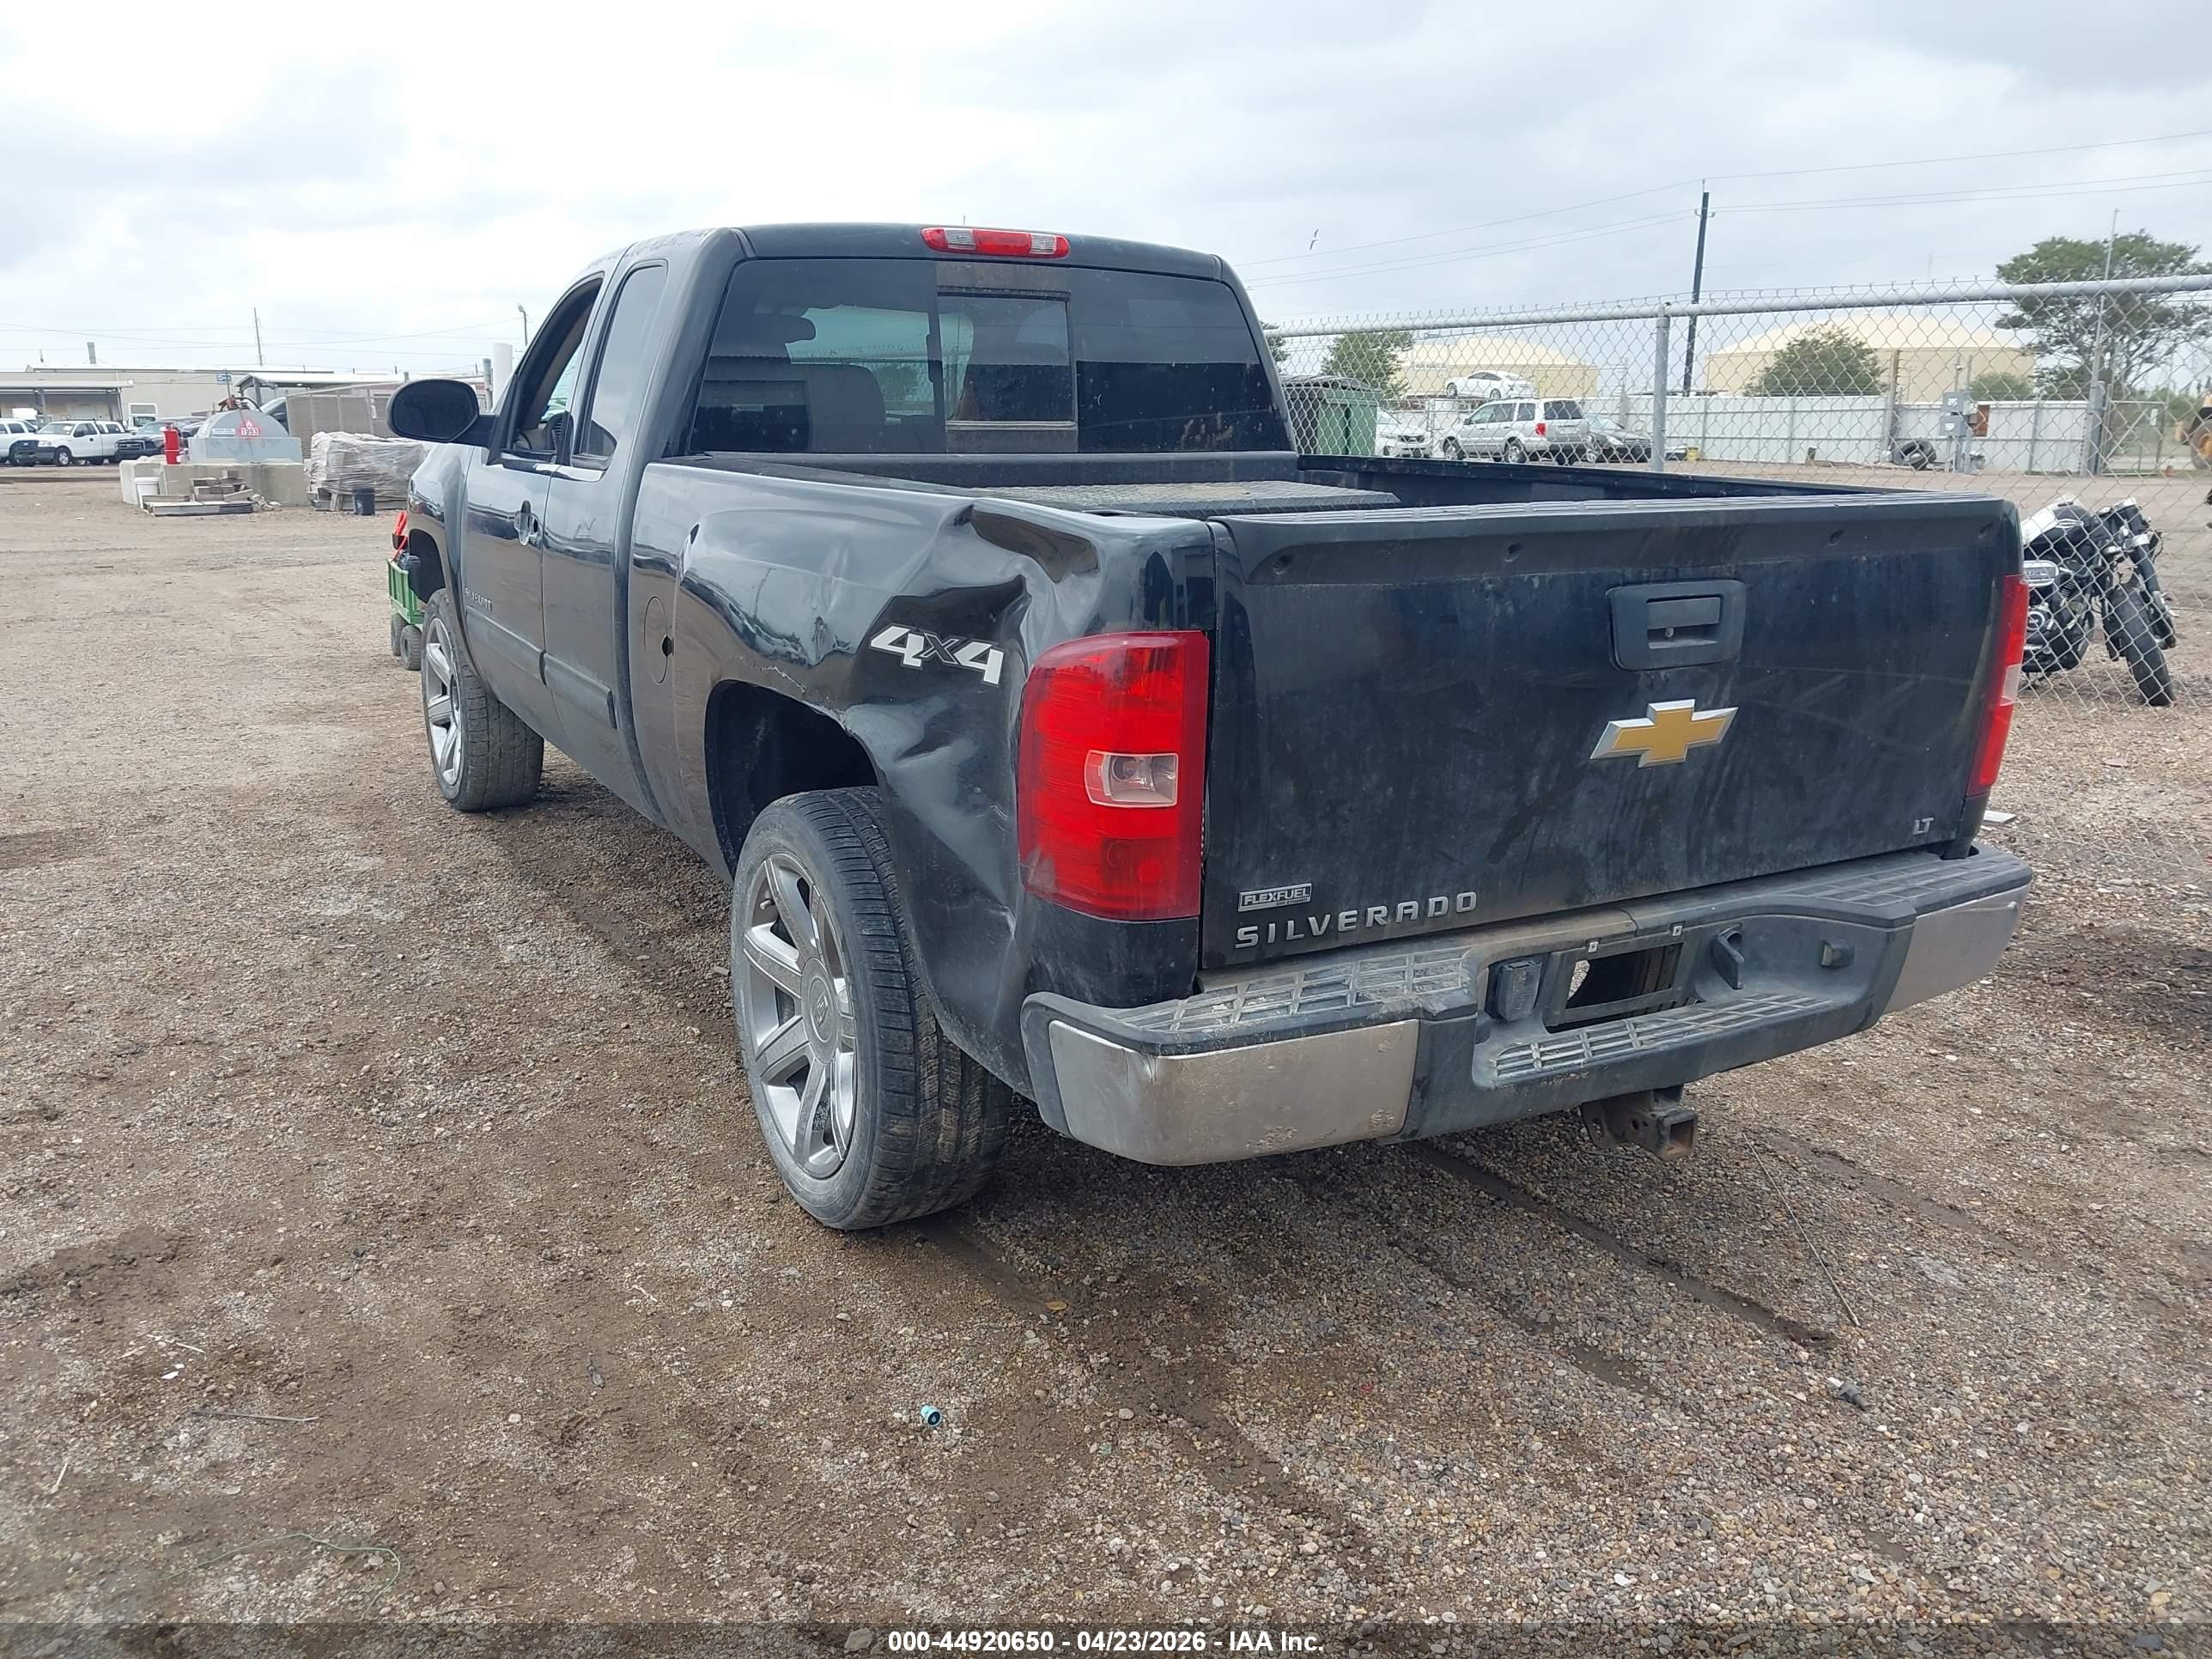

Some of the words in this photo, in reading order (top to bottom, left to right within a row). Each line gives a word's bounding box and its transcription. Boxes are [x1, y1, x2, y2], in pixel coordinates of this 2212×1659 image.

[1912, 817, 1935, 836] LT
[1243, 887, 1310, 906] FLEXFUEL
[1235, 891, 1478, 949] SILVERADO
